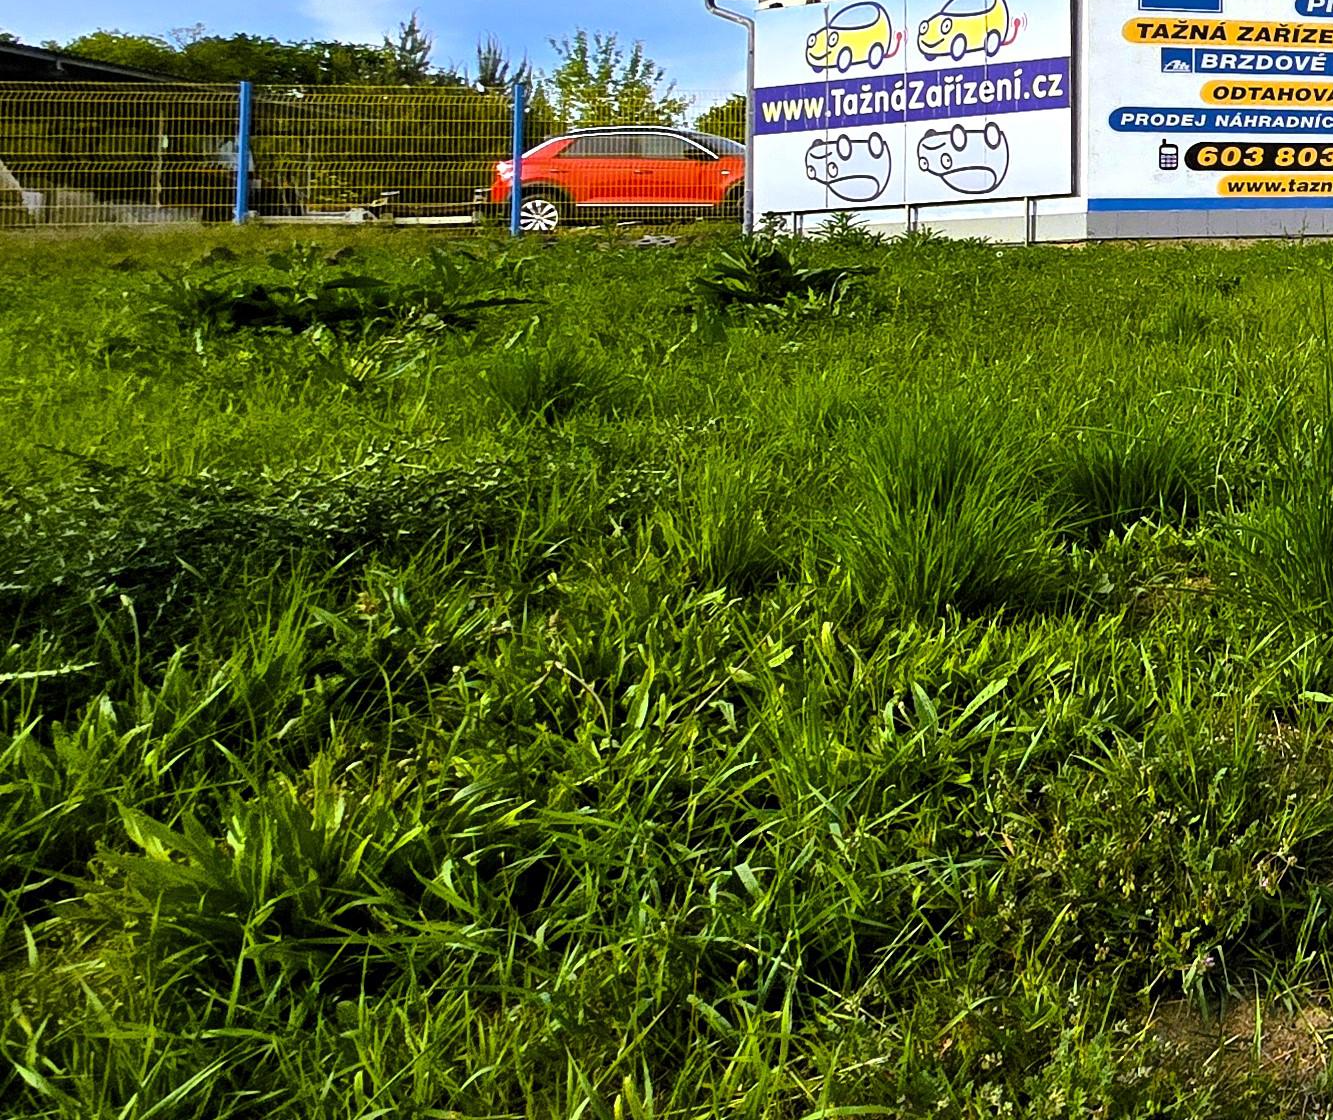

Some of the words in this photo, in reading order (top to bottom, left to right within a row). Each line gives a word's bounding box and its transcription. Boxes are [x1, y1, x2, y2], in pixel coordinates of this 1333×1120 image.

[1136, 20, 1228, 41] TAŽNÁ
[1200, 52, 1326, 72] BRZDOVÉ
[762, 68, 1064, 122] www.TažnáZařízení.cz
[1120, 113, 1207, 127] PRODEJ
[1197, 146, 1264, 166] 603
